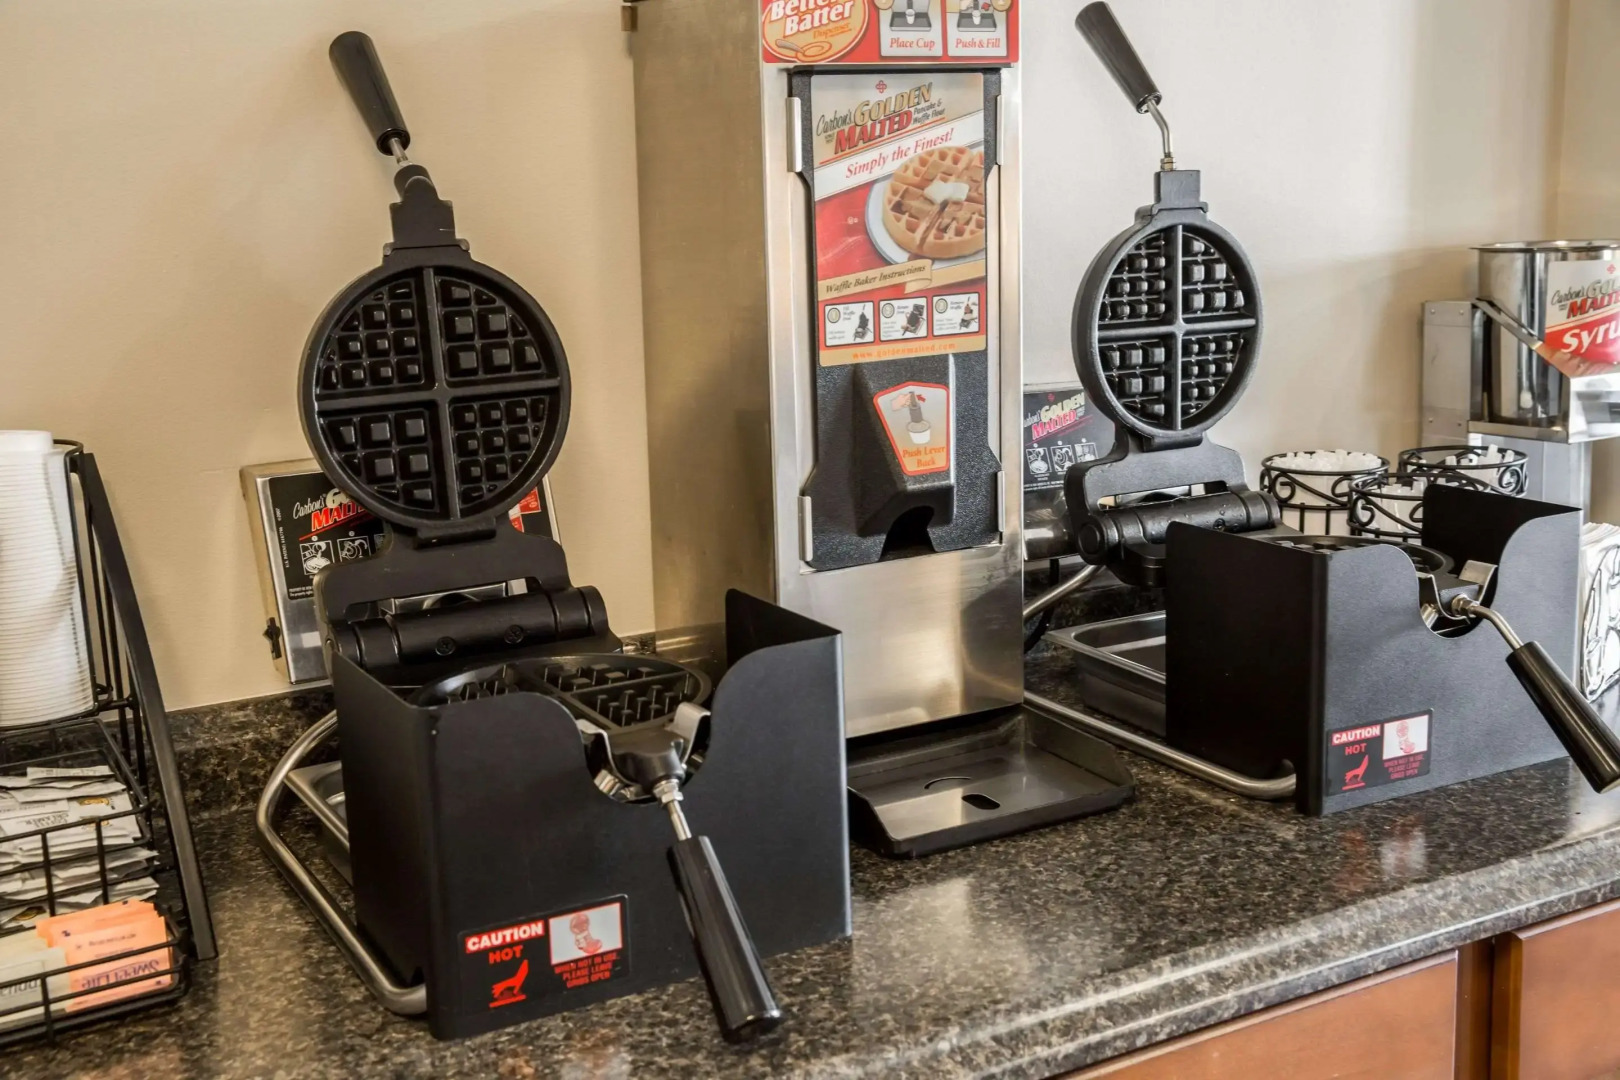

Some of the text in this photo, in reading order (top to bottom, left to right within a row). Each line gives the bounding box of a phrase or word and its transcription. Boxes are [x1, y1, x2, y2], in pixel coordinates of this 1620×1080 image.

[770, 0, 836, 21] Bett
[784, 1, 854, 38] Batter
[889, 37, 935, 51] Place Cup
[955, 37, 1000, 48] Push & Fill
[853, 82, 933, 127] GOLDEN
[816, 109, 853, 137] Carbon's
[834, 109, 913, 155] MALTED
[845, 127, 954, 179] Simply the Finest!
[826, 265, 926, 294] Waffle Baker Instructions
[1561, 319, 1620, 354] Syru
[852, 342, 956, 360] www.goldenmalted.com
[1032, 409, 1077, 440] MALTED
[903, 446, 945, 458] Push Lever
[916, 457, 936, 468] Back
[293, 494, 326, 520] Carbon's
[312, 500, 366, 532] MALT
[1333, 726, 1380, 744] CAUTION
[1345, 743, 1367, 755] HOT
[467, 921, 543, 951] CAUTION
[489, 945, 523, 964] HOT
